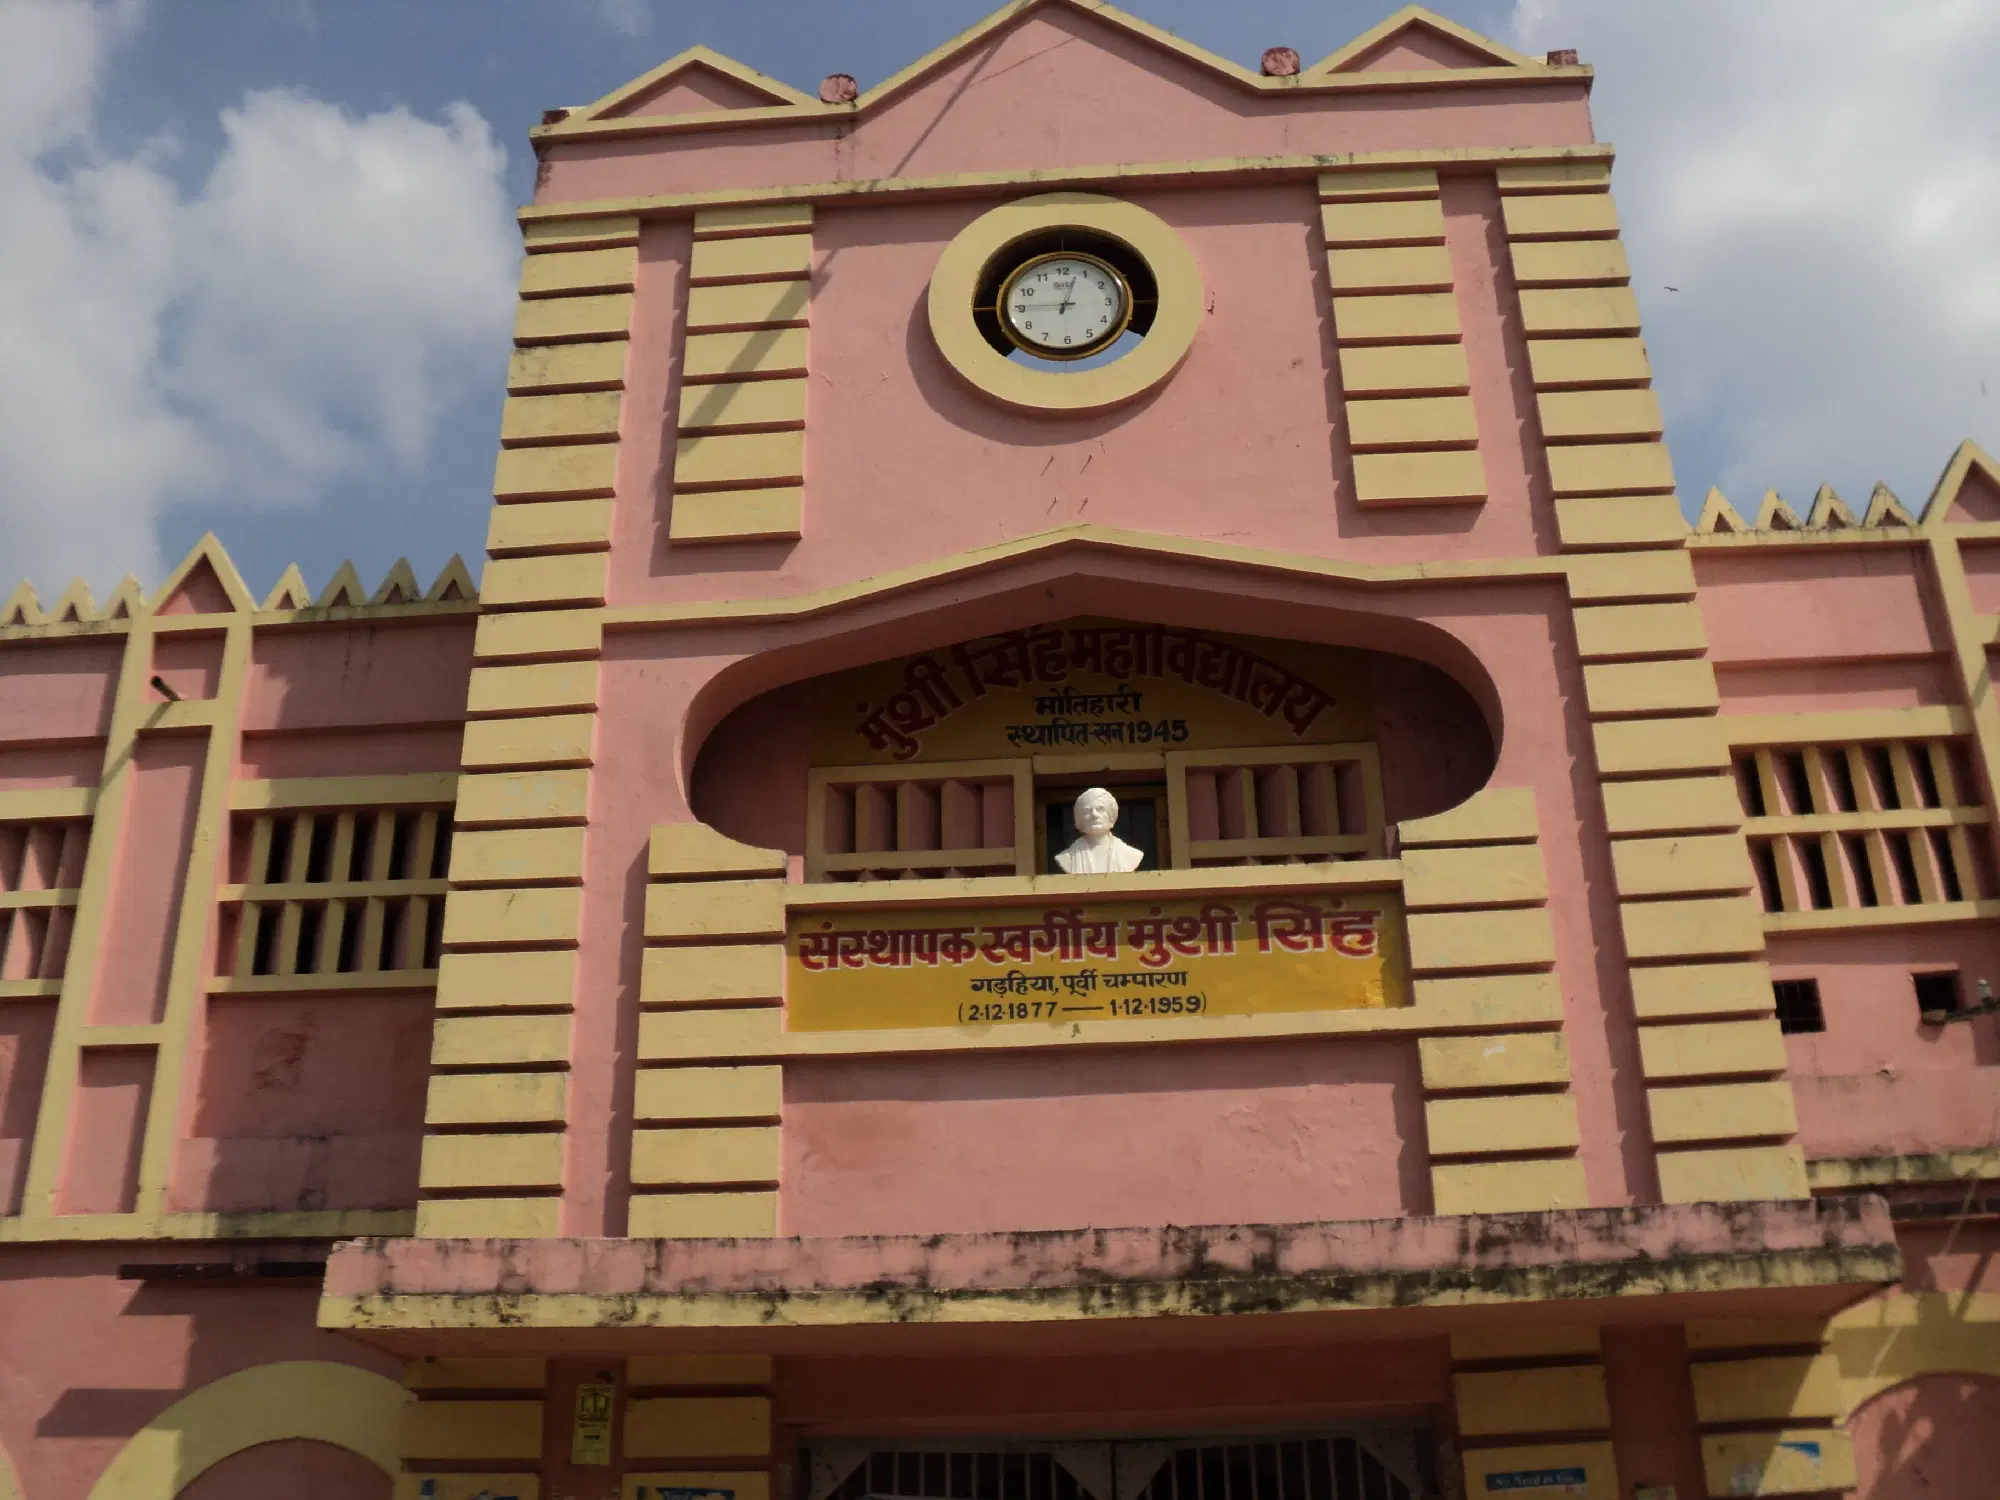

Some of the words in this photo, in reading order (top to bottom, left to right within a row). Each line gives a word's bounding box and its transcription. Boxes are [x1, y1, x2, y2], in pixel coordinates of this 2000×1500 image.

[1055, 267, 1070, 275] 12
[1082, 270, 1087, 278] 1
[1036, 273, 1048, 282] 11
[1097, 281, 1105, 290] 2
[1020, 287, 1034, 297] 10
[1104, 297, 1112, 307] 3
[1018, 304, 1026, 313] 9
[1100, 315, 1108, 324] 4
[1025, 320, 1033, 330] 8
[1042, 332, 1049, 342] 7
[1086, 329, 1093, 338] 5
[1064, 335, 1072, 345] 6
[1033, 684, 1143, 717] मोतिहारी
[855, 656, 966, 761] मुंशी
[1126, 719, 1190, 744] 1945
[798, 920, 979, 973] संस्थापक
[980, 908, 1122, 965] स्वर्गीय
[1126, 903, 1242, 969] मुंशी
[1249, 899, 1385, 959] सिंह
[1060, 968, 1099, 997] पूर्वी
[1101, 971, 1188, 989] चम्पारण
